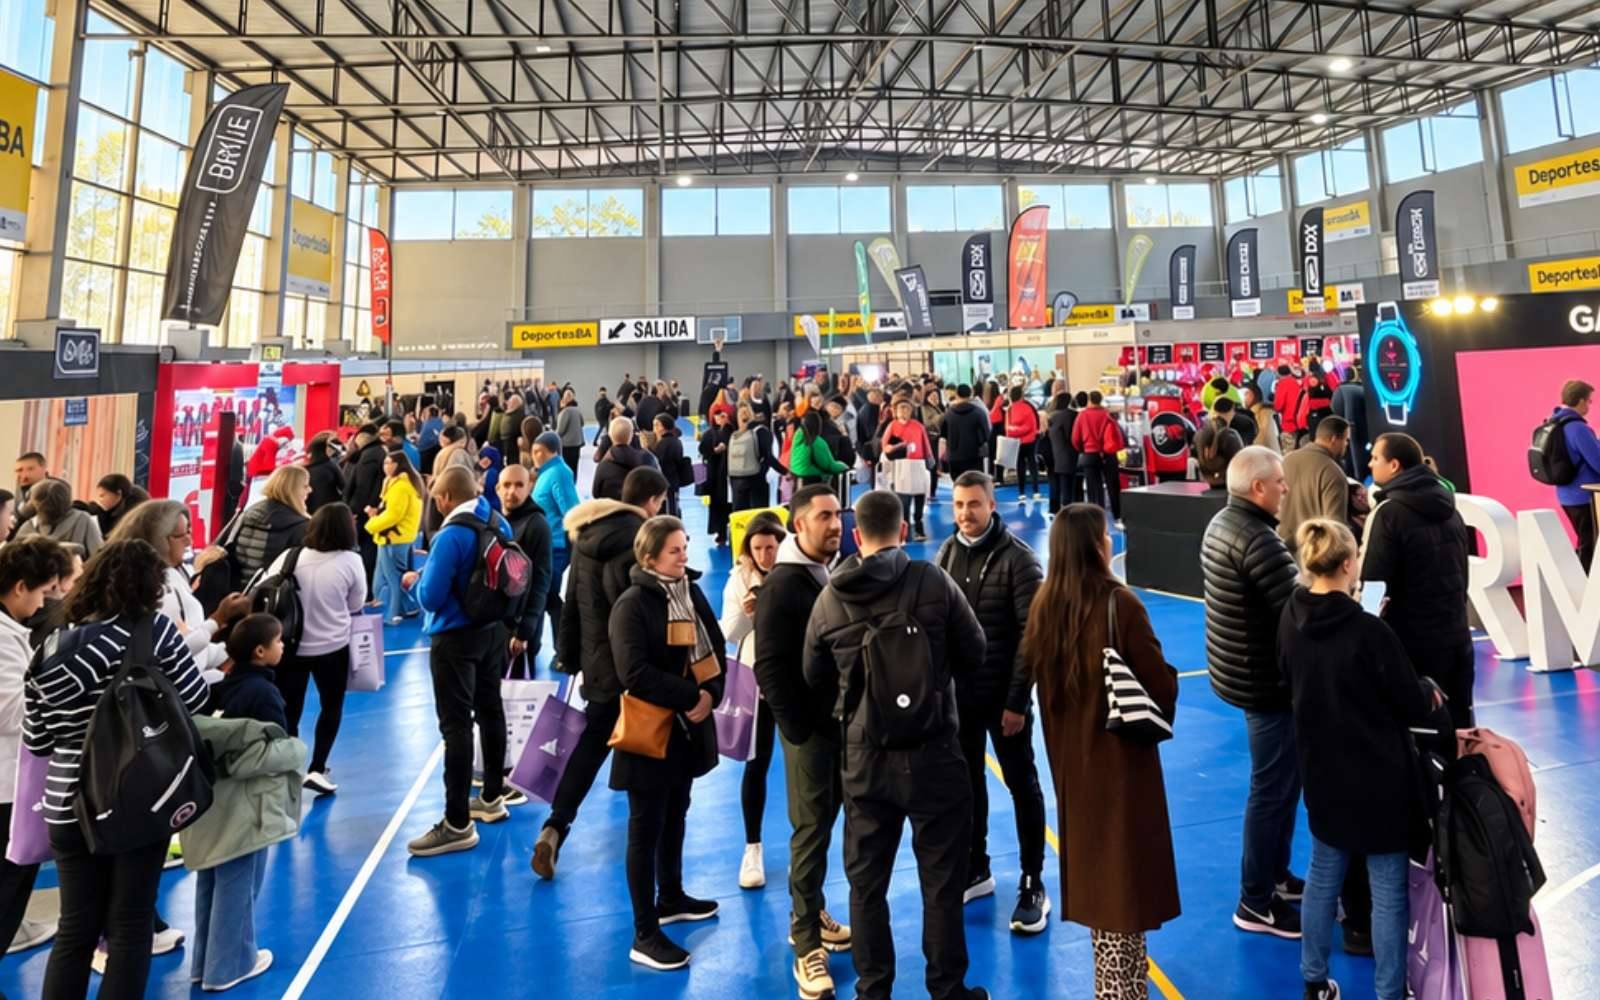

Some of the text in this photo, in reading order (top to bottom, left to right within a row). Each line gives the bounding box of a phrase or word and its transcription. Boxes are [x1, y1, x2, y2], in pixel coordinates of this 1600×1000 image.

[1529, 159, 1600, 185] Deportes
[634, 319, 689, 338] SALIDA
[1569, 304, 1600, 333] G
[521, 328, 592, 342] DeportesBA
